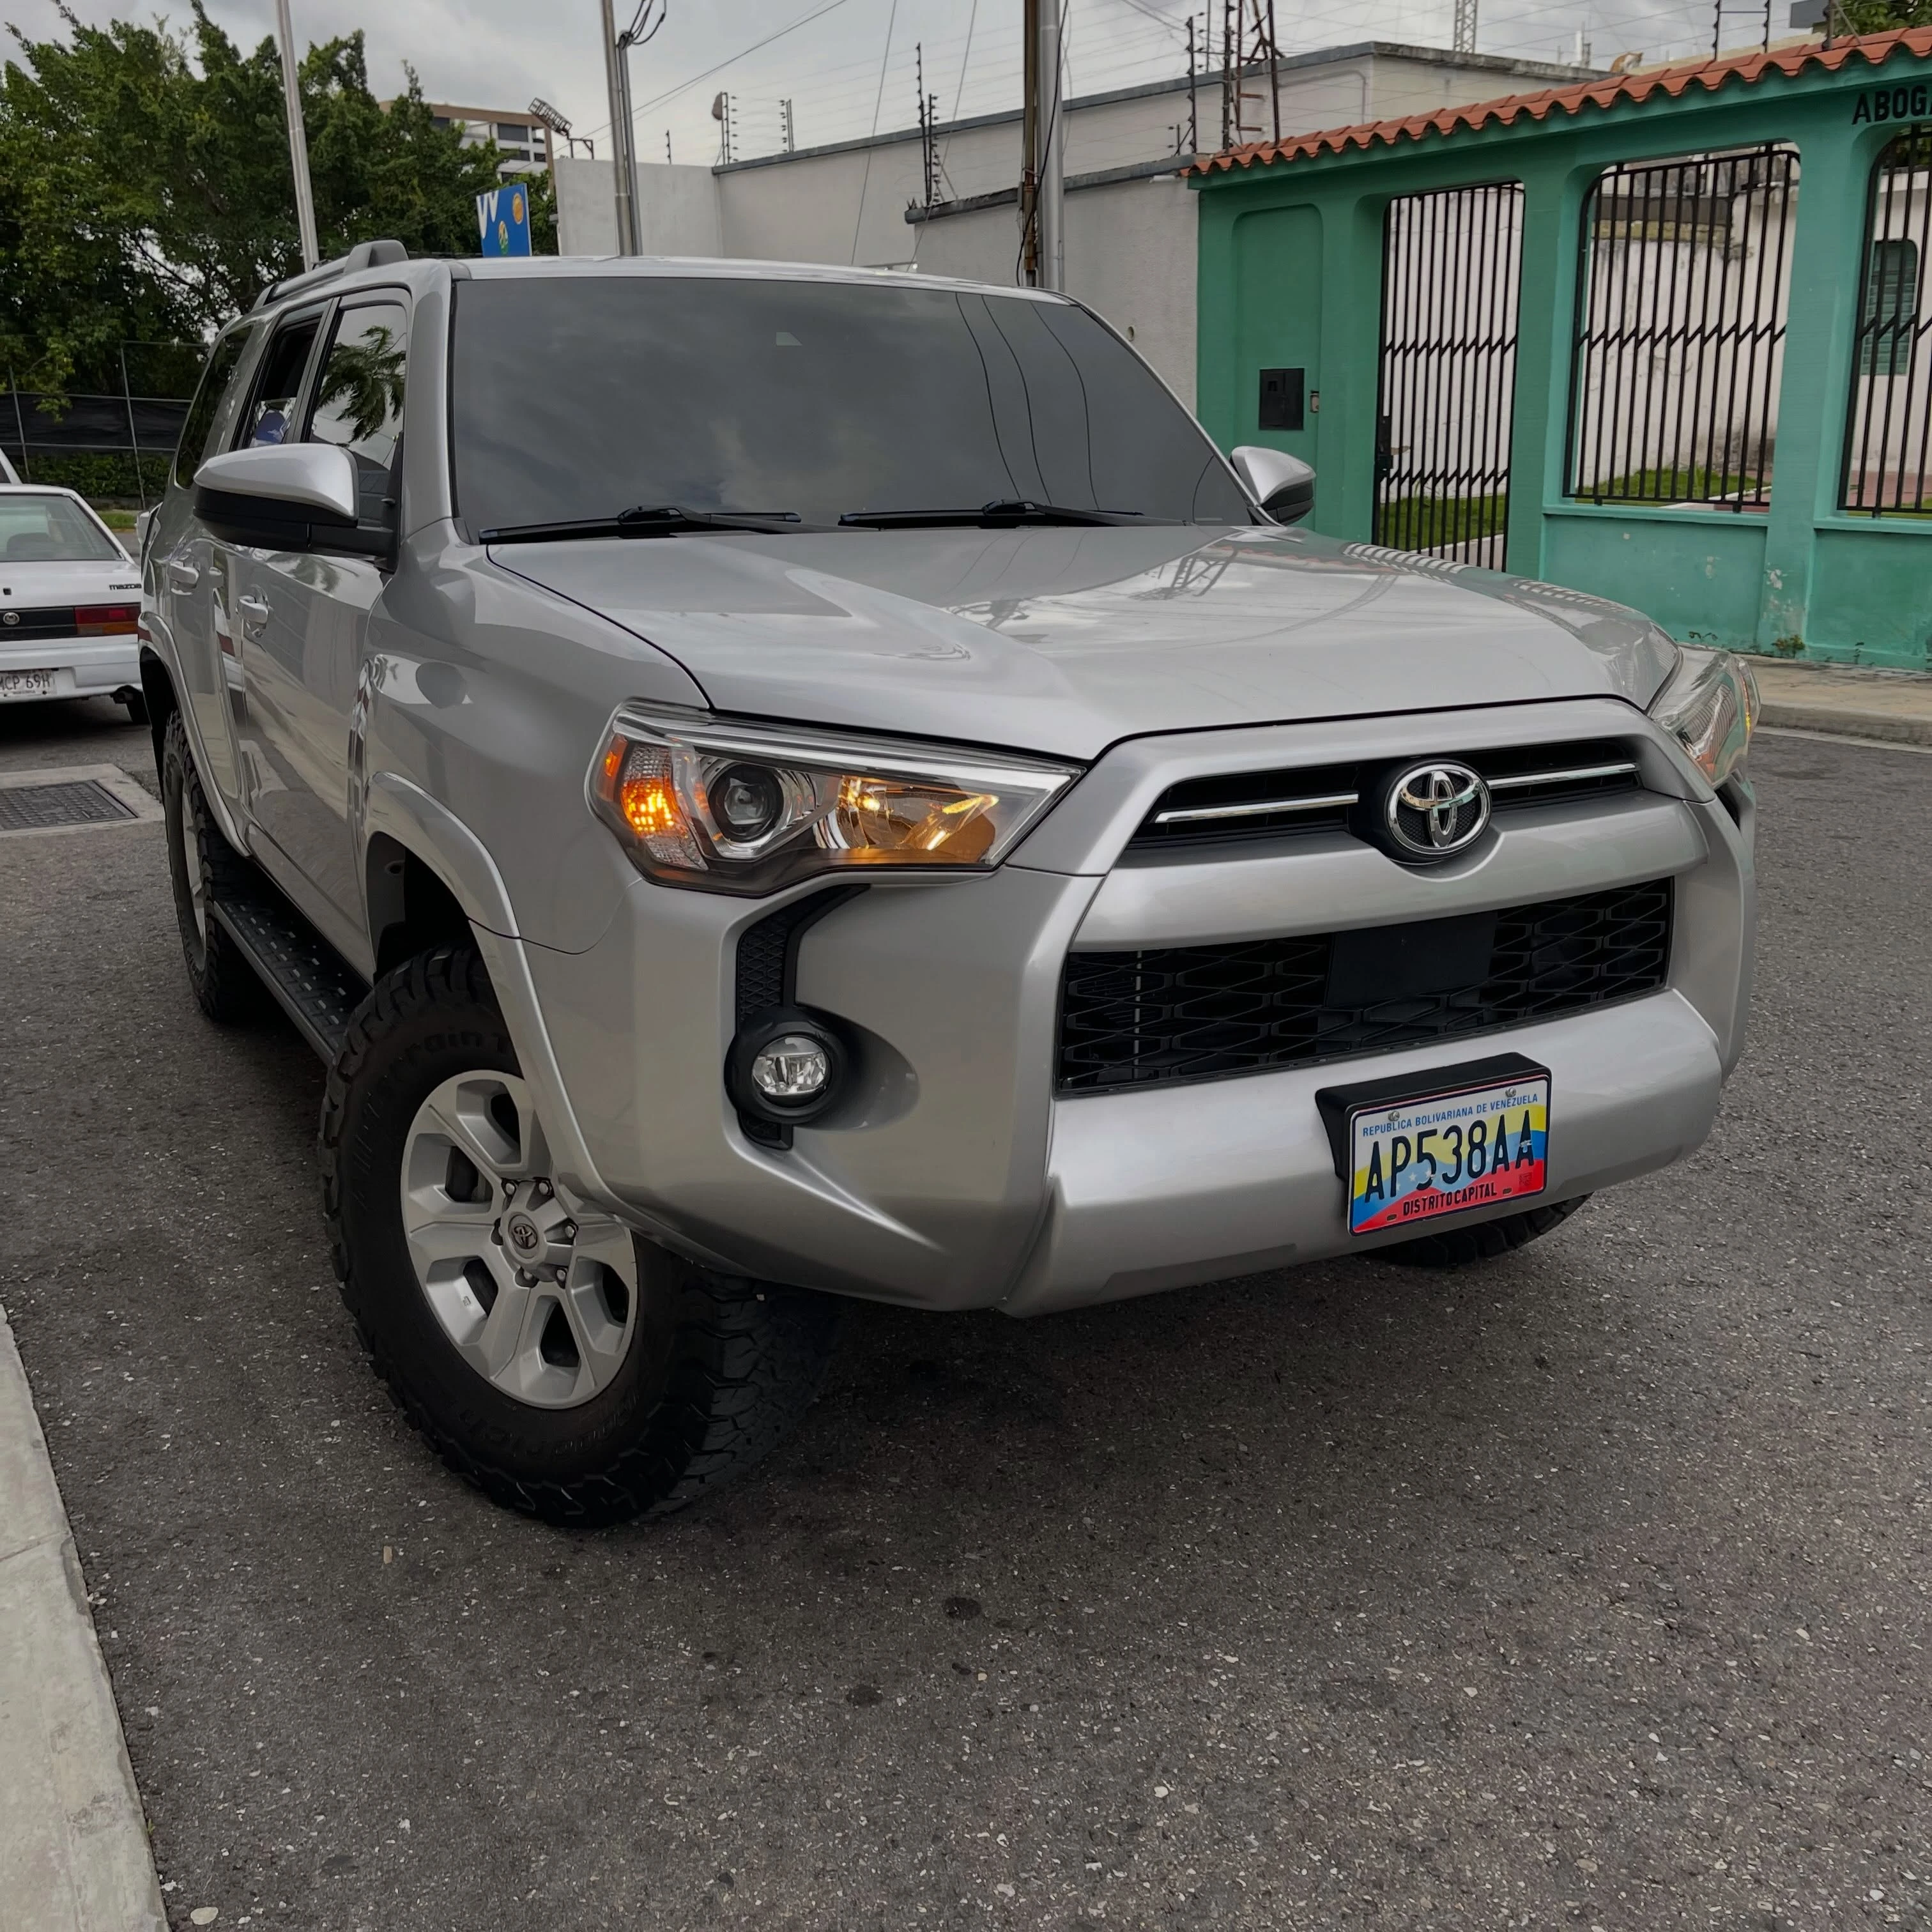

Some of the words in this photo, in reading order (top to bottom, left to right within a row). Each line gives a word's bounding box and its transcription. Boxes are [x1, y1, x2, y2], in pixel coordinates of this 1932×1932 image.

[1851, 85, 1932, 125] ABOG
[1363, 1120, 1412, 1137] REPUBLICA
[1415, 1107, 1473, 1126] BOLIVARIANA
[1476, 1104, 1487, 1114] DE
[1490, 1093, 1538, 1112] VENEZUELA
[1364, 1110, 1535, 1204] AP538AA
